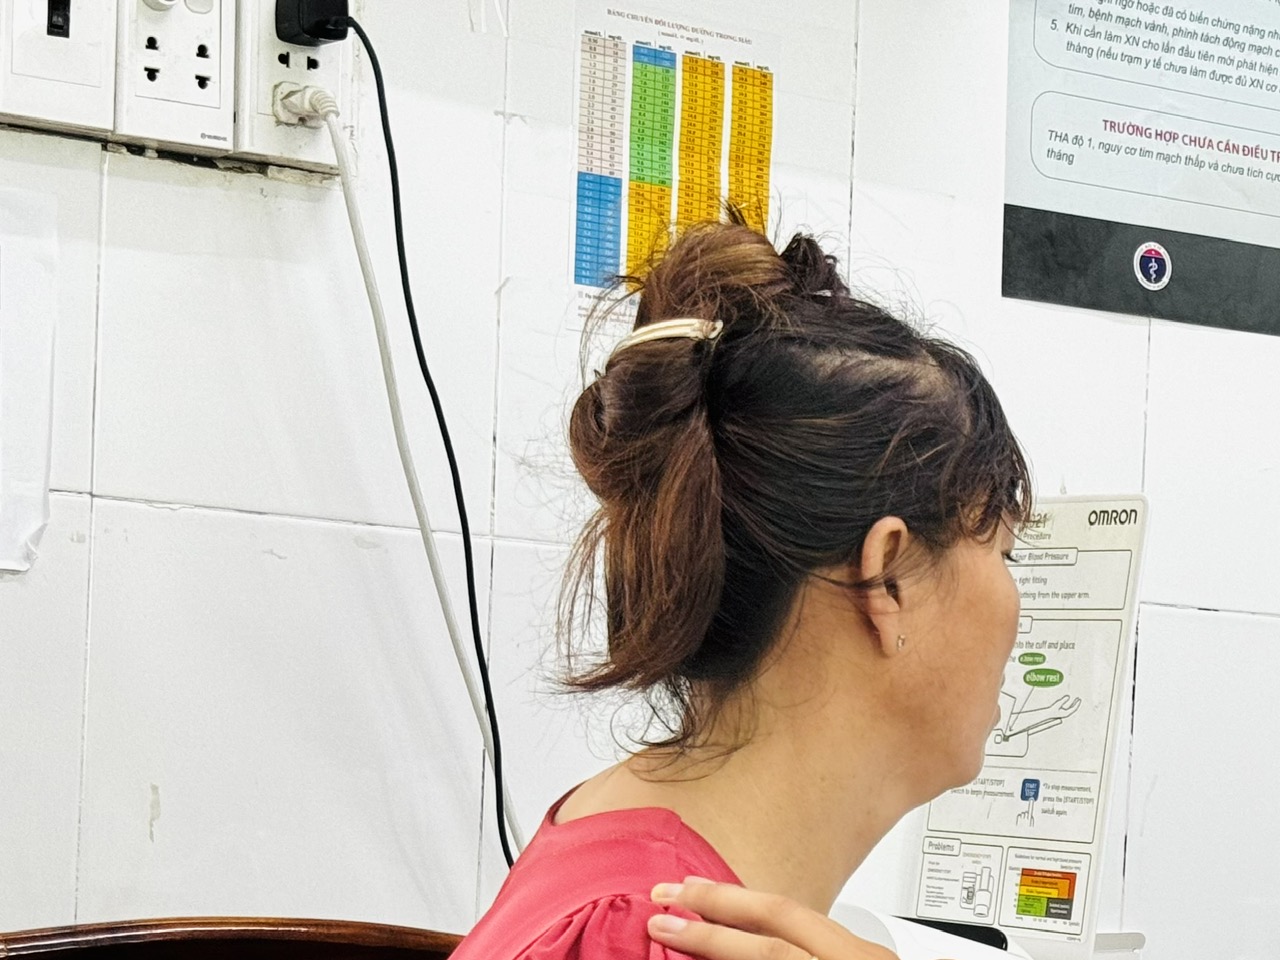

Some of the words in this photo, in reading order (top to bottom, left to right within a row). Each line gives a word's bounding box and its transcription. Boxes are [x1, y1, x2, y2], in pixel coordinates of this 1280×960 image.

[1068, 3, 1085, 18] tim,
[1050, 18, 1058, 31] 5.
[1065, 21, 1082, 35] Khi
[1123, 33, 1140, 47] XN
[1141, 38, 1159, 51] cho
[1143, 58, 1151, 69] y
[1248, 77, 1264, 90] XN
[1047, 129, 1069, 144] THA
[1087, 137, 1094, 150] 1,
[1098, 141, 1122, 155] nguy
[1138, 147, 1153, 159] tim
[1046, 147, 1074, 165] tháng
[1088, 509, 1138, 526] OMRON
[928, 840, 955, 853] Problems
